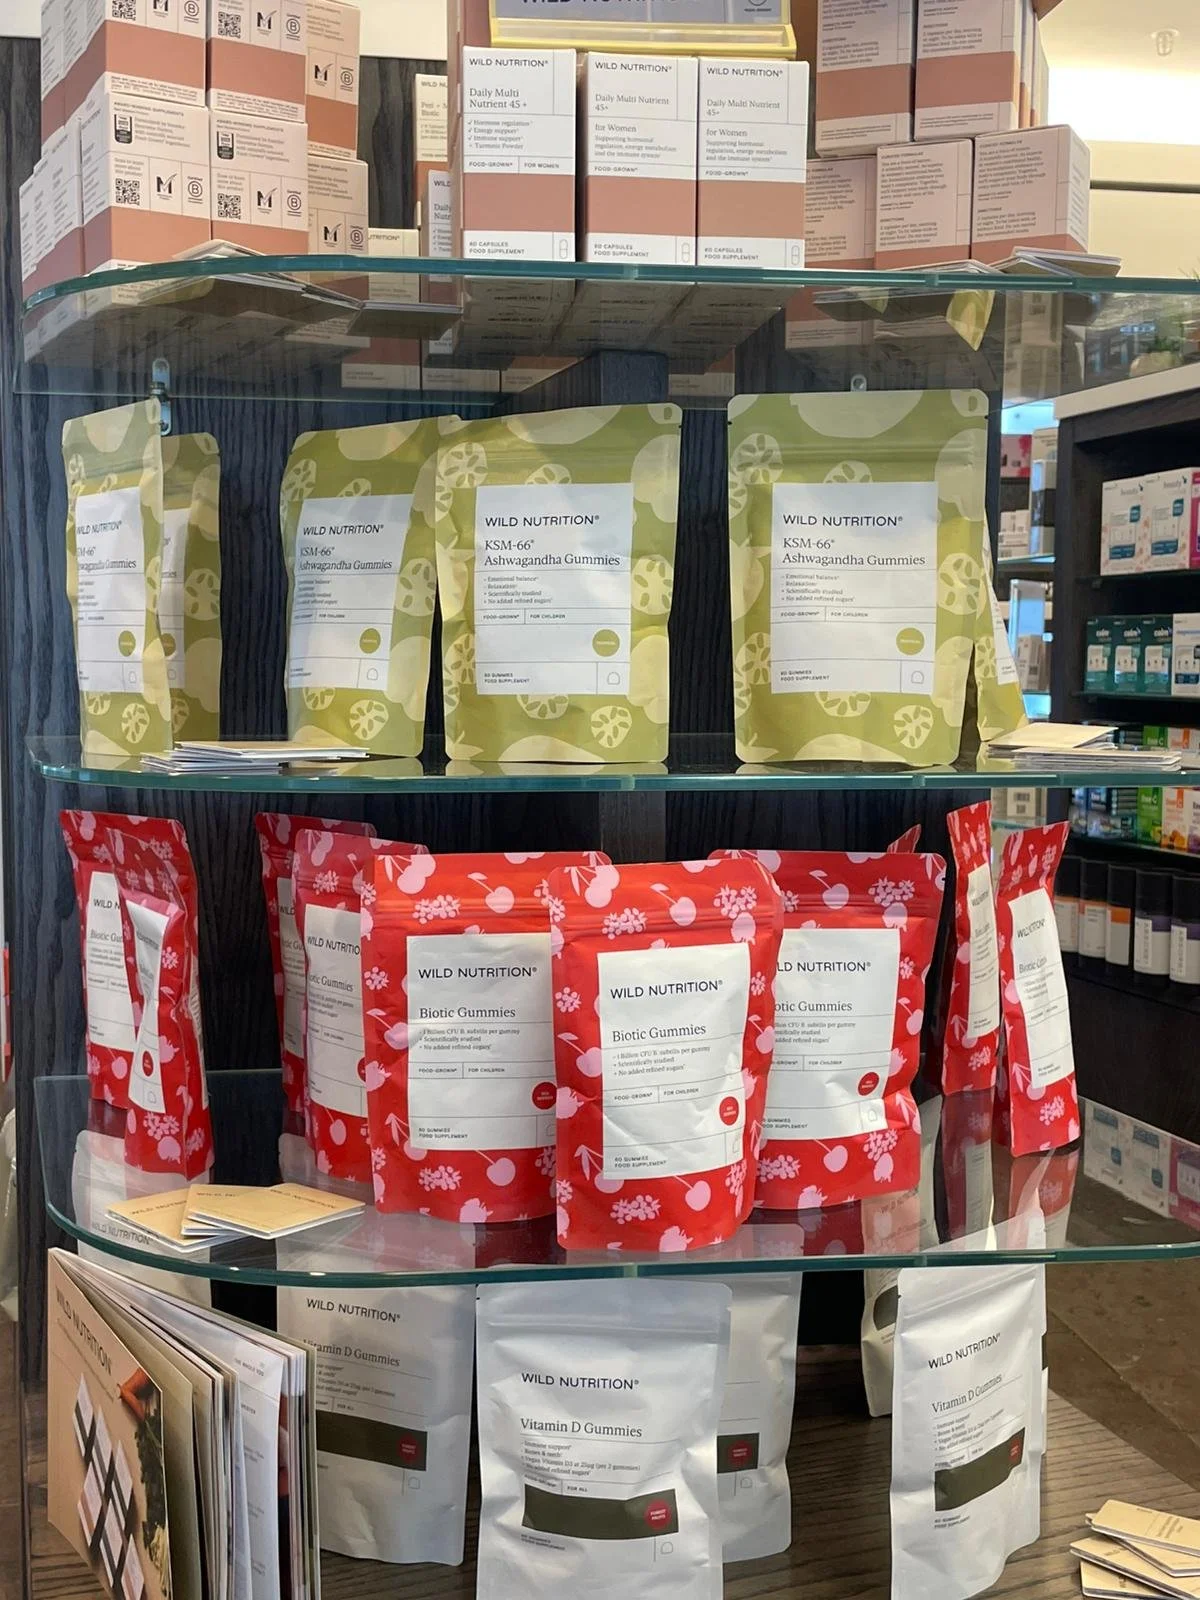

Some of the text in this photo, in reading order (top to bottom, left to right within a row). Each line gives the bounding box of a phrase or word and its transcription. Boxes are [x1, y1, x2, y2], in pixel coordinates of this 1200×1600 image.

[469, 58, 492, 66] WILD
[595, 62, 617, 70] WILD
[469, 88, 520, 98] Daily Multi
[469, 100, 521, 109] Nutrient 45
[596, 94, 669, 104] Daily Multi Nutrient
[707, 99, 780, 108] Daily Multi Nutrient
[607, 124, 637, 132] Women
[485, 517, 518, 527] WILD
[783, 515, 817, 525] WILD
[303, 526, 326, 536] WILD
[106, 558, 136, 568] Gummies
[353, 560, 392, 570] Gummies
[484, 553, 620, 568] Ashwagandha Gummies
[782, 553, 926, 567] Ashwagandha Gummies
[93, 898, 113, 909] WILD
[307, 936, 323, 947] WILD
[325, 940, 360, 955] NUTRITIO
[777, 962, 792, 972] LD
[419, 968, 453, 978] WILD
[321, 976, 353, 992] Gummies
[610, 986, 644, 999] WILD
[775, 1000, 853, 1012] otic Gummies
[420, 1006, 516, 1018] Biotic Gummies
[612, 1024, 706, 1042] Biotic Gummies
[307, 1298, 334, 1311] WILD
[73, 1310, 112, 1376] NUTRITION
[344, 1347, 352, 1356] D
[354, 1348, 400, 1366] Gummies
[928, 1353, 953, 1369] WILD
[522, 1373, 555, 1385] WILD
[932, 1374, 1002, 1413] Vitamin D Gummies
[520, 1418, 642, 1437] Vitamin D Gummies
